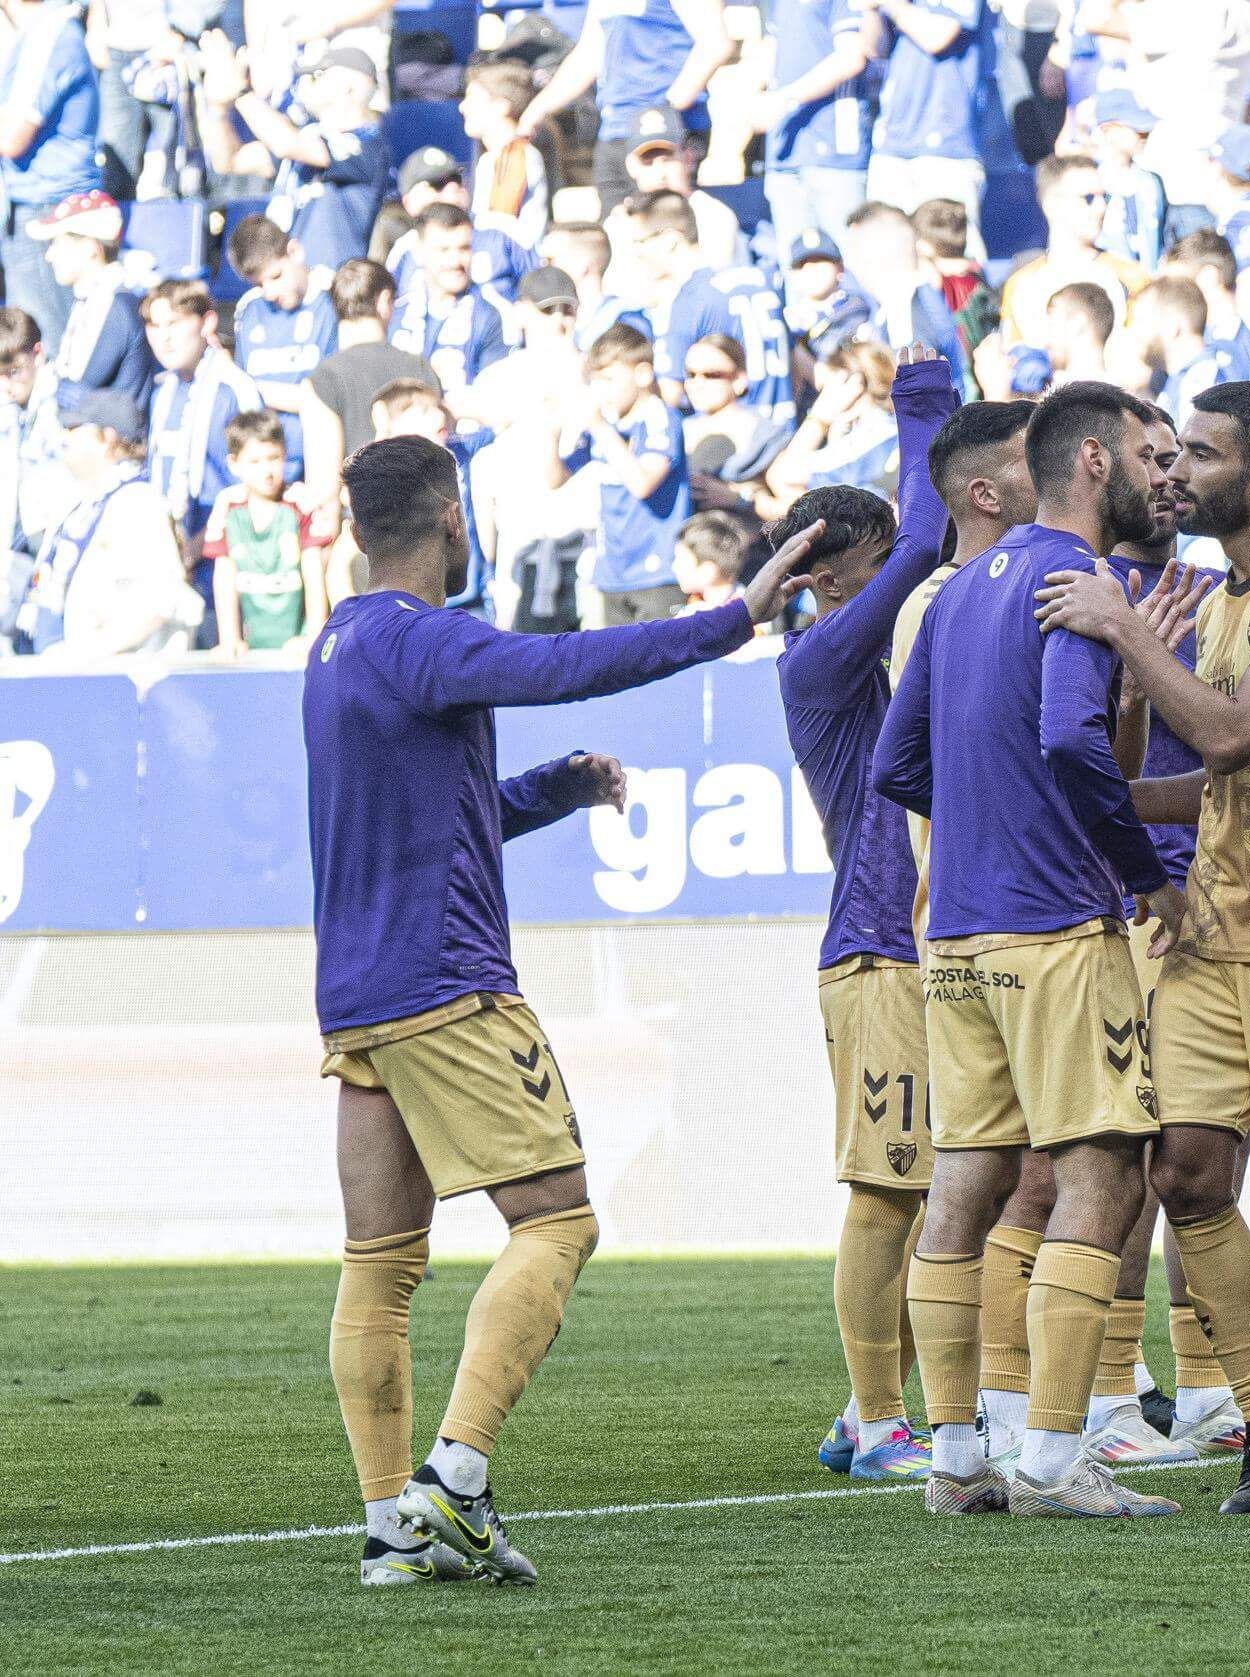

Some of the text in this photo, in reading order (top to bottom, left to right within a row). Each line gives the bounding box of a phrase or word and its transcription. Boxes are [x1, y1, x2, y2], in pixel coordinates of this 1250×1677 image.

[992, 971, 1025, 990] SOL
[925, 985, 986, 1003] MÁLAG
[895, 1073, 932, 1132] 1
